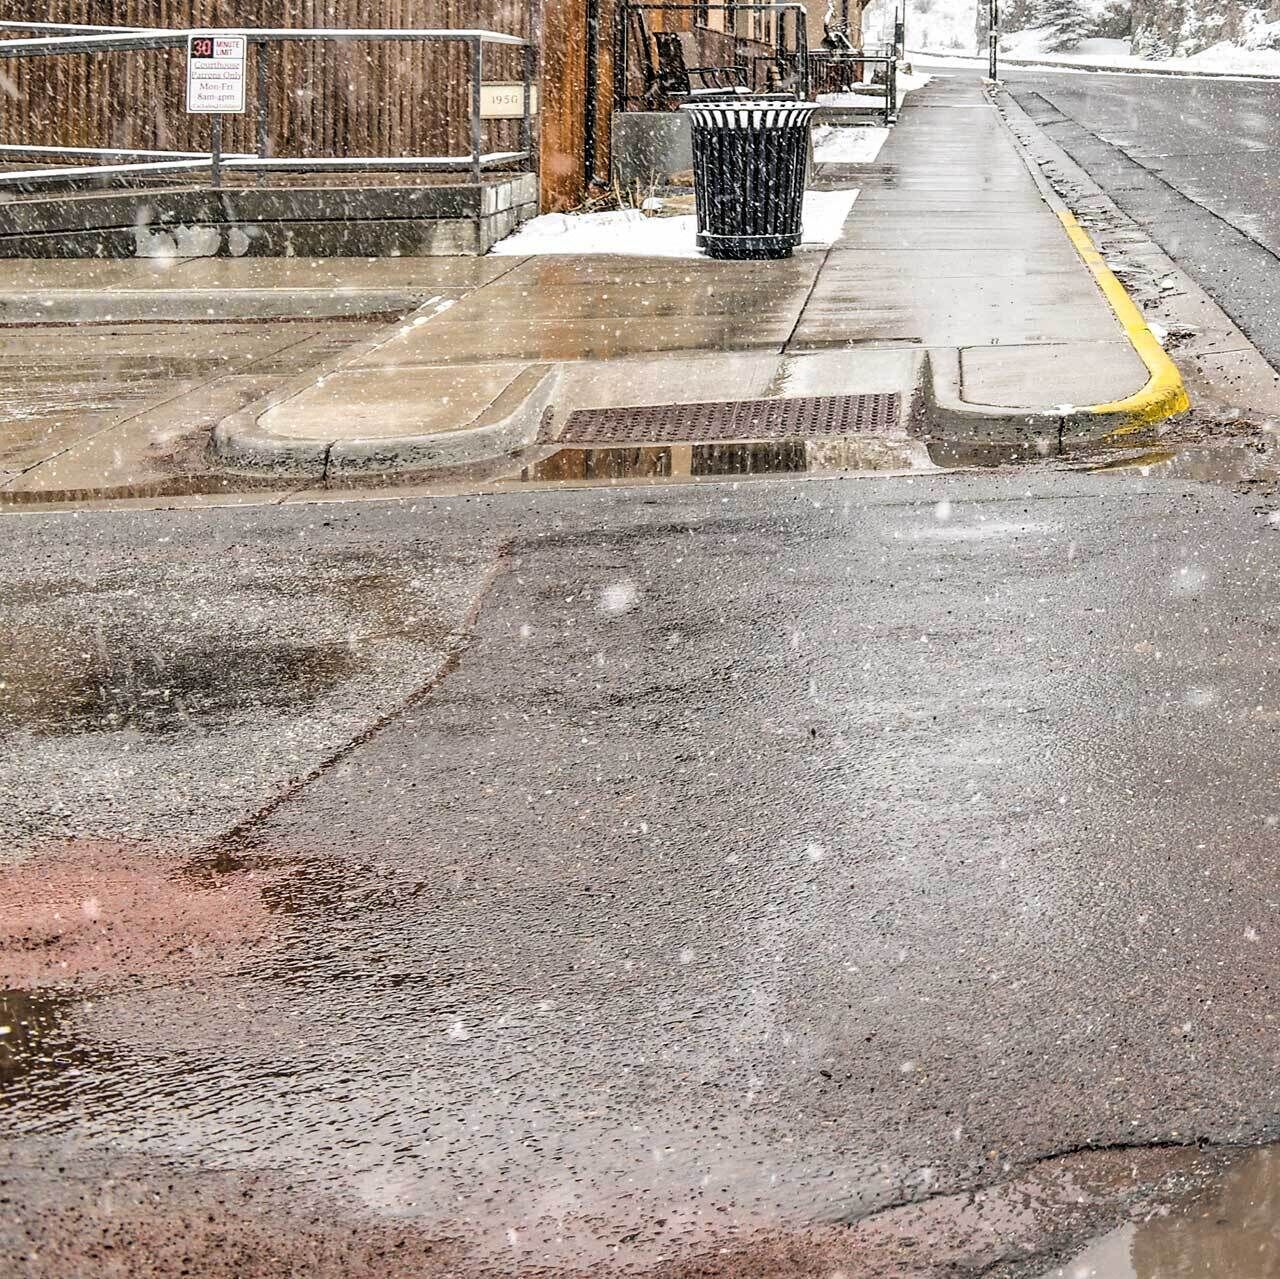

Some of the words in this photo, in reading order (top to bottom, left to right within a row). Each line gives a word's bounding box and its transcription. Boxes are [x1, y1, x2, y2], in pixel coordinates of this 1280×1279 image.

[194, 39, 212, 56] 30
[194, 61, 240, 69] Courthouse
[192, 71, 221, 79] Patrons
[223, 71, 241, 80] Only
[199, 82, 233, 90] Mon-Fri
